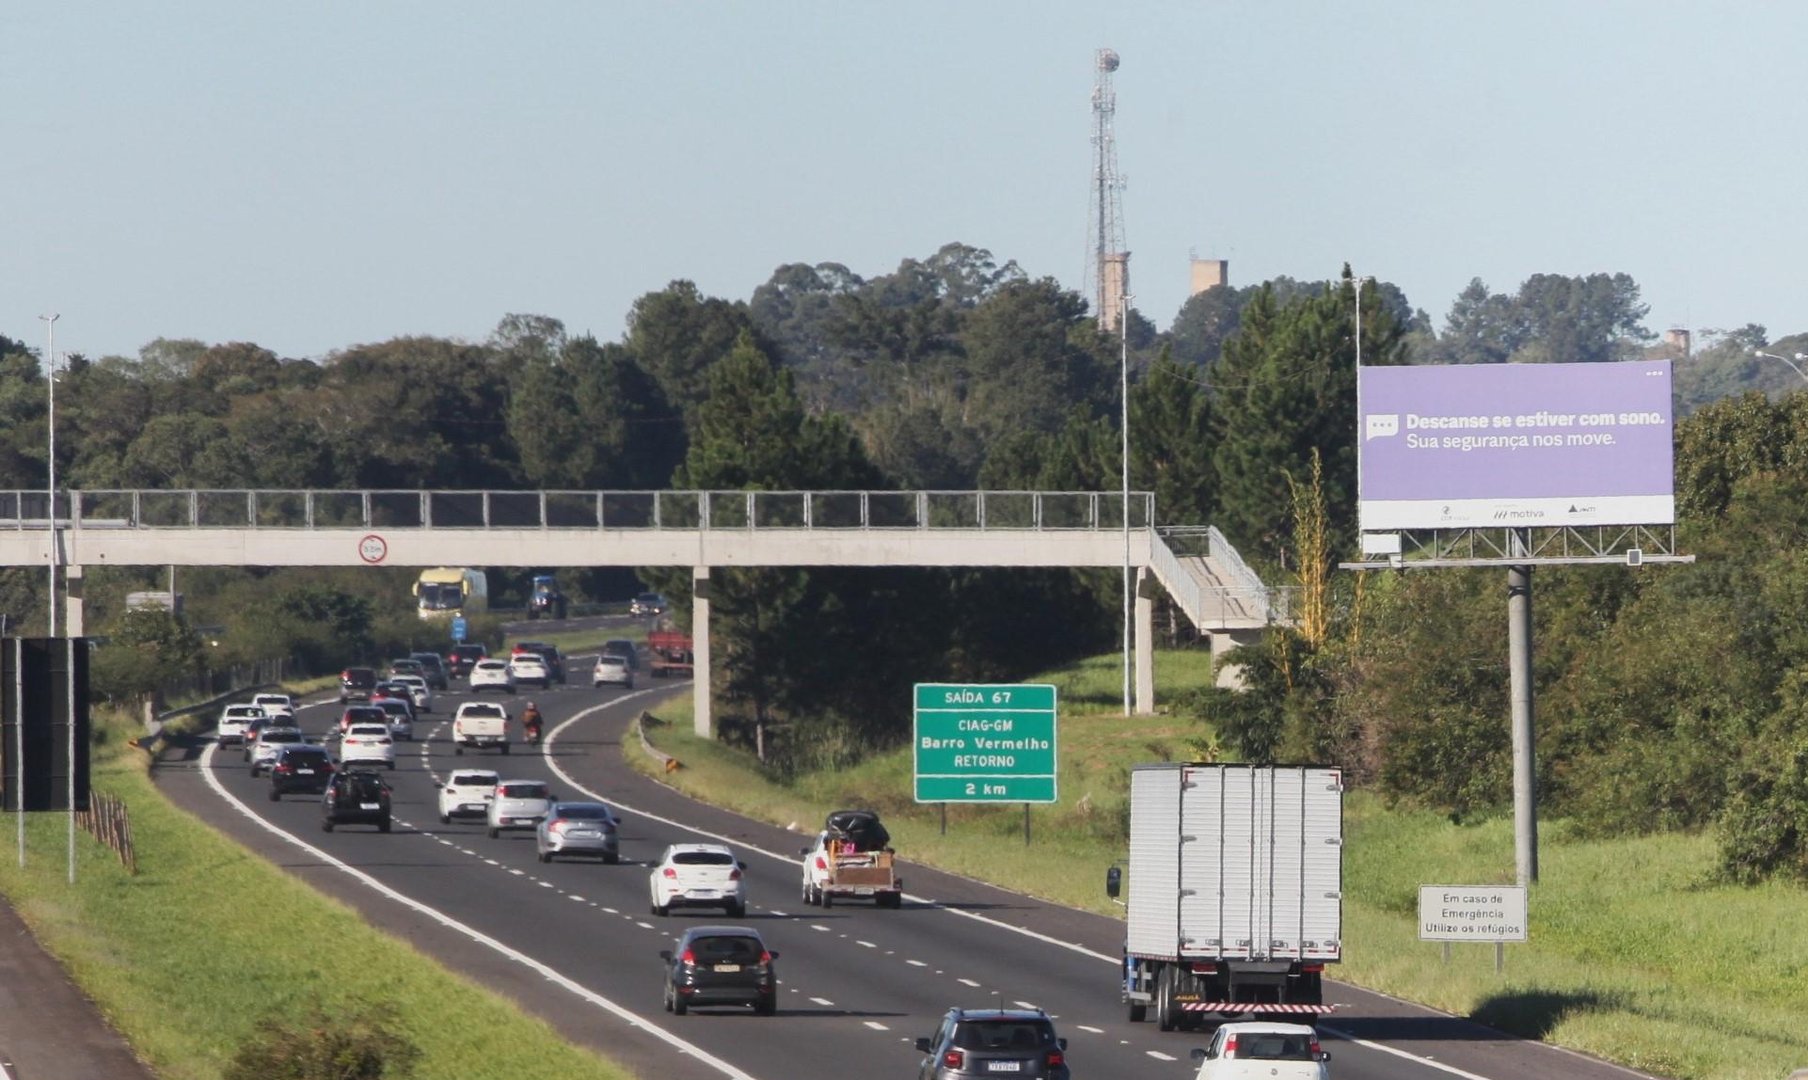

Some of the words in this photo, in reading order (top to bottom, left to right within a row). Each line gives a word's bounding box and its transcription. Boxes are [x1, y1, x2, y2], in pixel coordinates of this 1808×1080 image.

[1406, 413, 1489, 429] Descanse
[1492, 415, 1512, 428] se
[1515, 411, 1576, 427] estiver
[1579, 413, 1616, 426] com
[1619, 411, 1665, 425] sono.
[1406, 433, 1439, 449] Sua
[1442, 434, 1529, 451] segurança
[1532, 433, 1563, 447] nos
[1567, 432, 1617, 446] move.
[1510, 510, 1544, 518] motiva
[945, 688, 984, 703] SAÍDA
[992, 692, 1012, 703] 67
[958, 720, 1013, 731] CIAG-GM
[921, 737, 965, 749] Barro
[974, 737, 1049, 750] Vermelho
[954, 755, 1015, 767] RETORNO
[965, 783, 976, 795] 2
[984, 784, 1007, 795] km
[1443, 893, 1460, 903] Em
[1462, 895, 1488, 904] caso
[1490, 894, 1503, 904] de
[1441, 908, 1504, 921] Emergência
[1425, 923, 1458, 933] Utilize
[1461, 925, 1474, 934] os
[1477, 924, 1520, 936] refúgios
